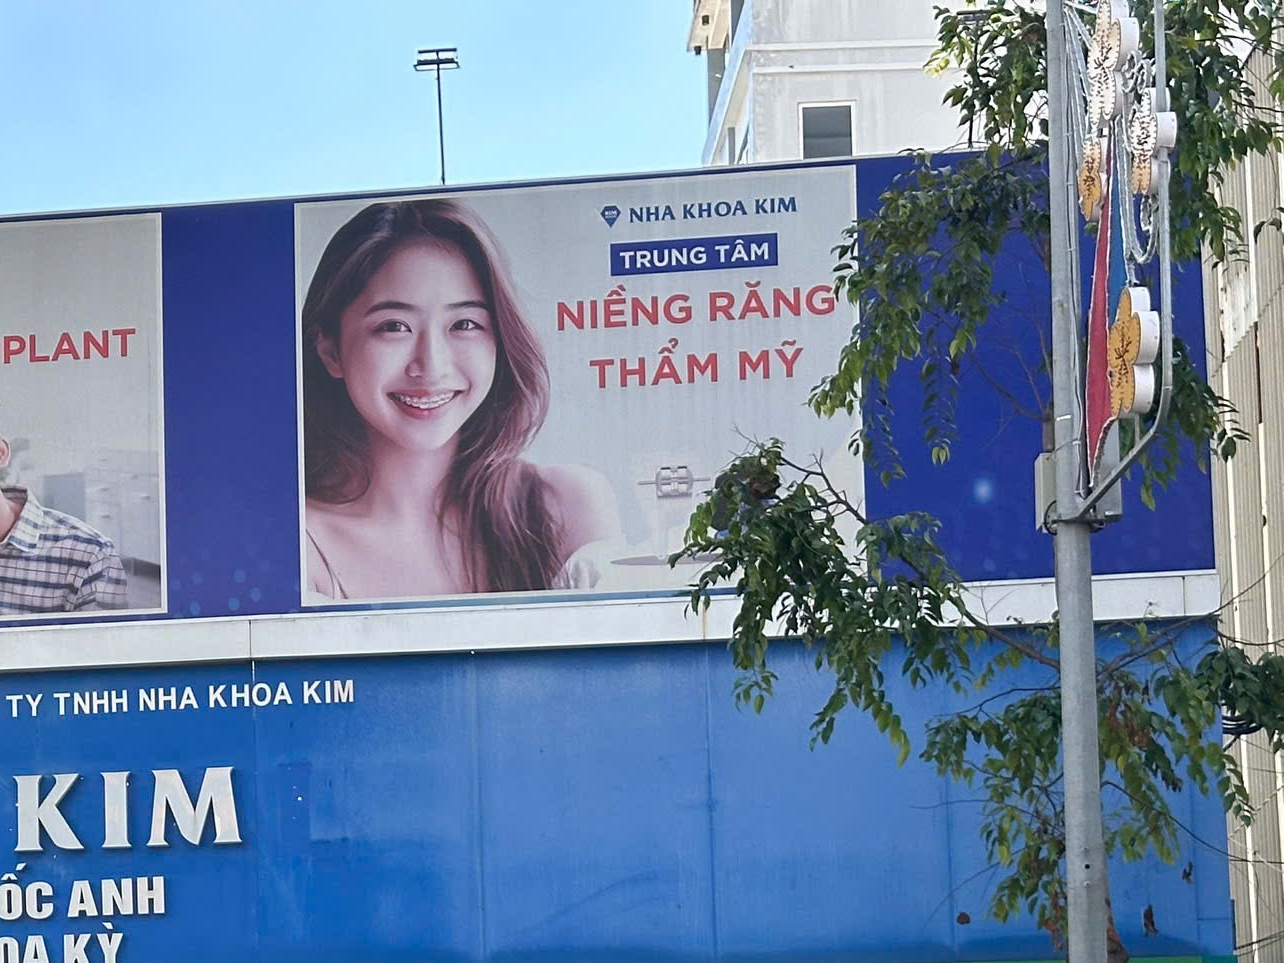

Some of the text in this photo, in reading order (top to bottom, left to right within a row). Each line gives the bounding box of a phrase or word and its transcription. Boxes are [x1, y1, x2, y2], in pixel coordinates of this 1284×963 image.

[629, 197, 797, 223] NHA KHOA KIM
[620, 240, 769, 269] TRUNG TÂM
[557, 281, 836, 331] NIỀNG RĂNG
[590, 338, 803, 389] THẨM MỸ
[6, 693, 43, 717] TY
[53, 690, 128, 716] TNHH
[139, 686, 198, 712] NHA
[208, 682, 293, 709] KHOA
[302, 679, 354, 705] KIM
[14, 766, 242, 853] KIM
[69, 876, 165, 918] ANH
